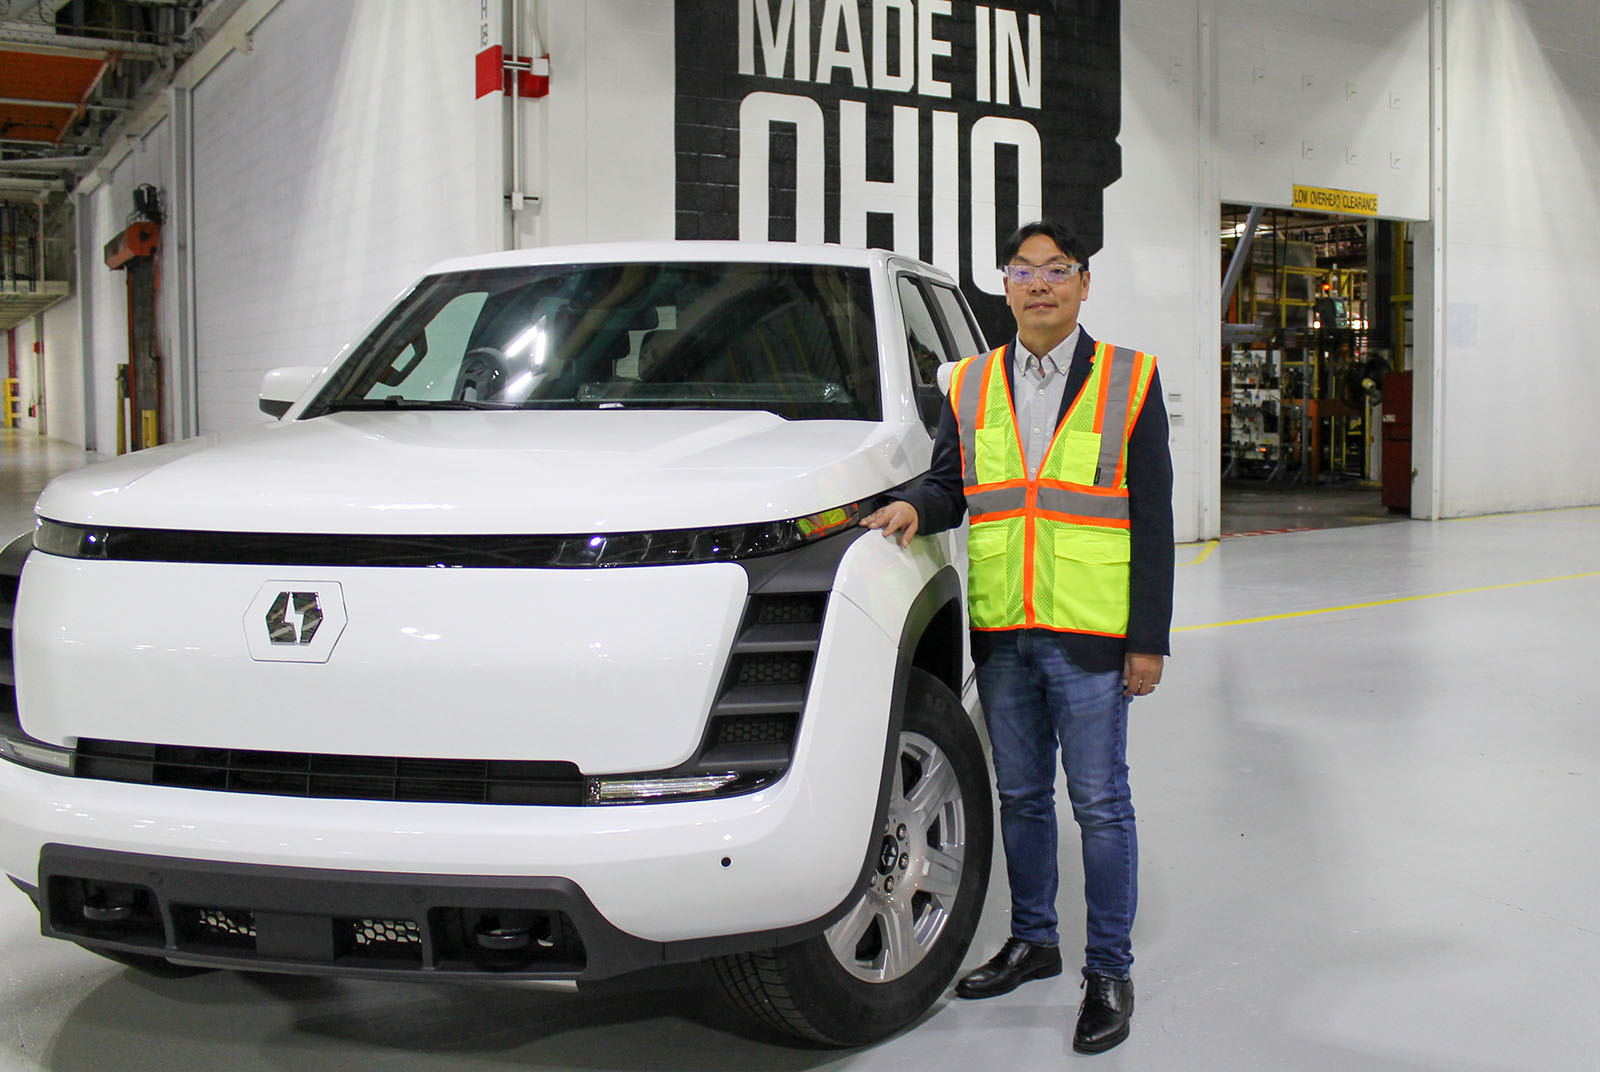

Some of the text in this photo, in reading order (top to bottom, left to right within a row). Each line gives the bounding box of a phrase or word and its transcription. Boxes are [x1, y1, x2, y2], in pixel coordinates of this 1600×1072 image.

[738, 0, 1041, 109] MADE IN
[739, 91, 1042, 295] OHIO
[1294, 188, 1377, 212] LOW OVERHEAD CLEARANCE
